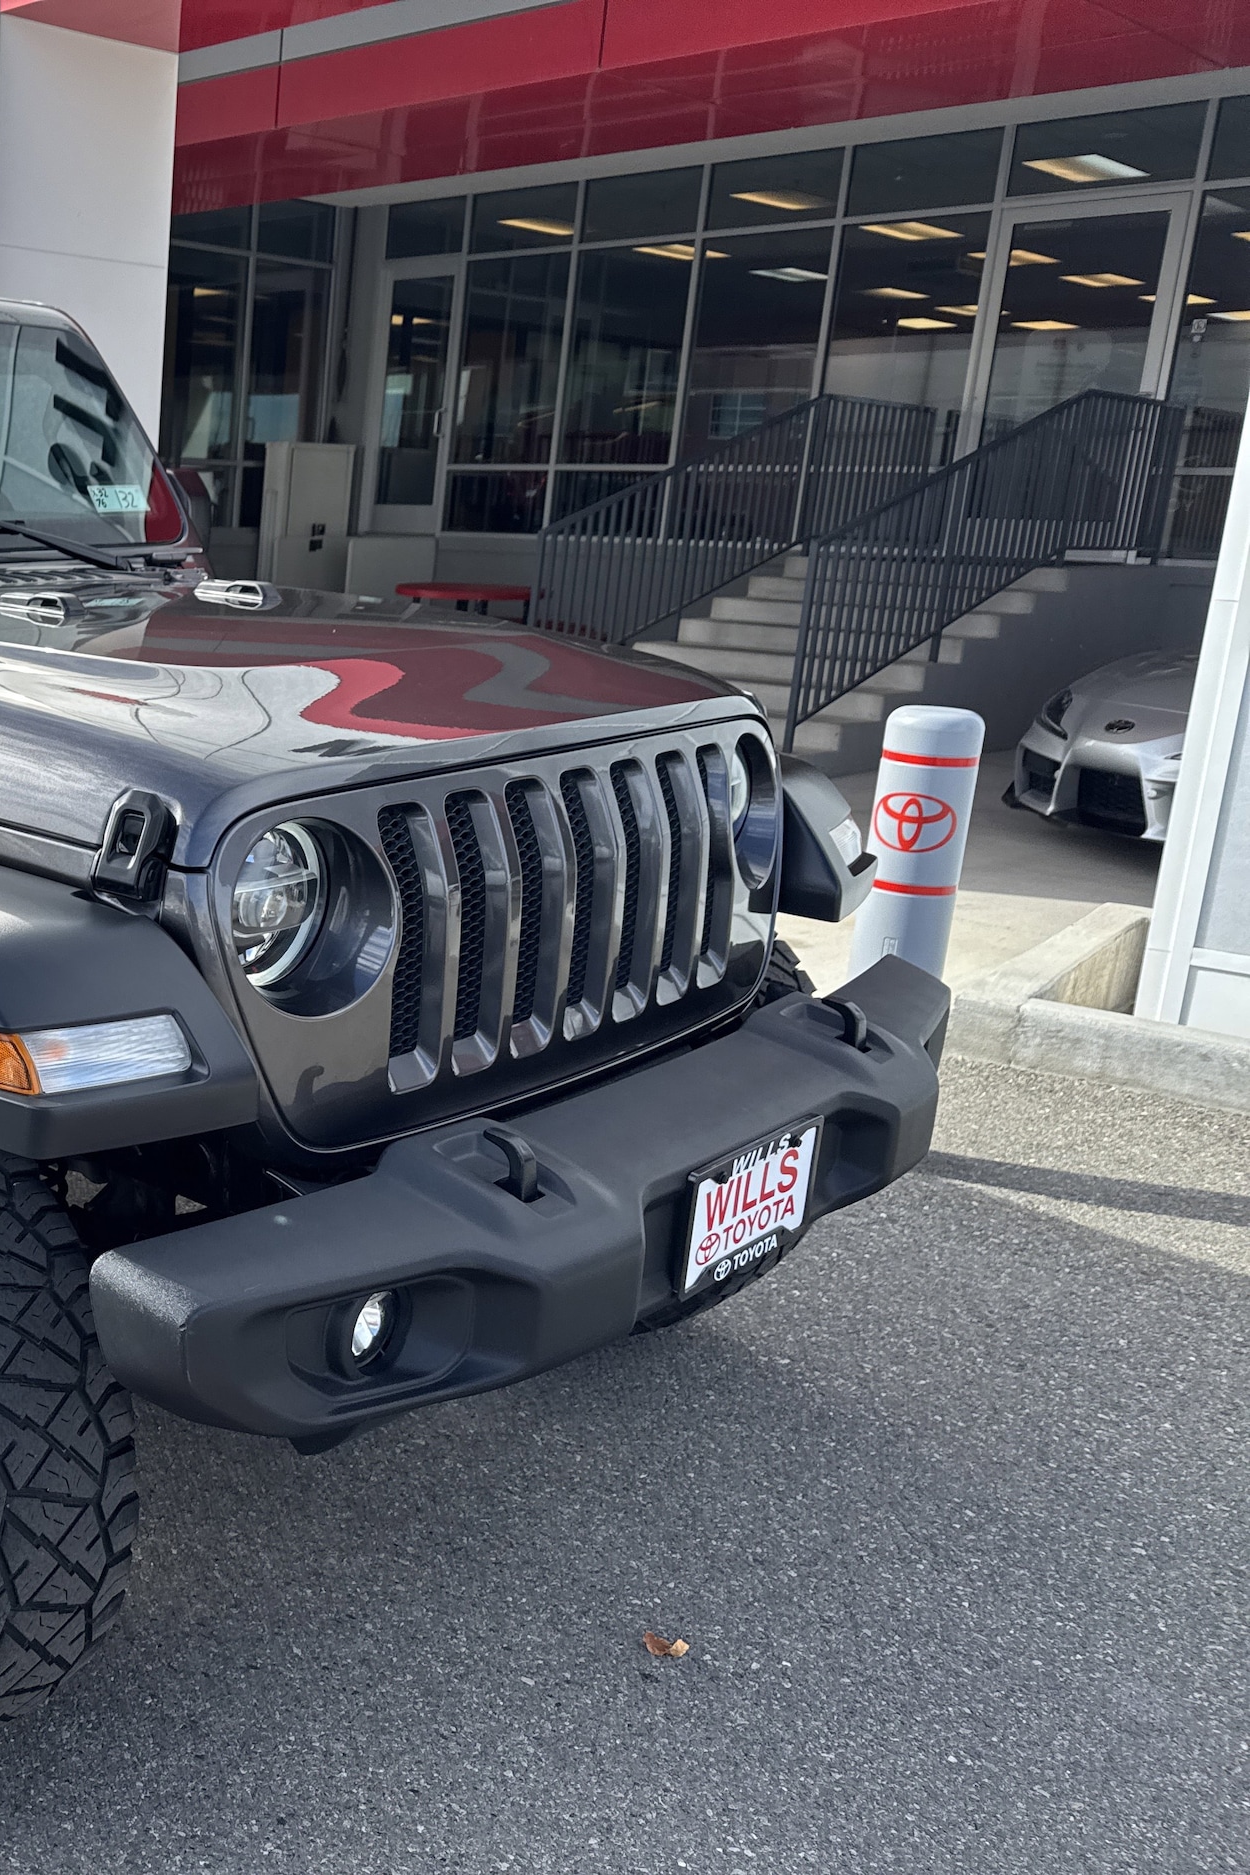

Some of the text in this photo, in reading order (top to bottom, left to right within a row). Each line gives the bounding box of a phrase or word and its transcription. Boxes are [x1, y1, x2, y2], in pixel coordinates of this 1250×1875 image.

[731, 1132, 792, 1176] WILLS
[706, 1149, 799, 1232] WILLS
[723, 1194, 795, 1250] TOYOTA
[733, 1233, 778, 1270] TOYOTA
